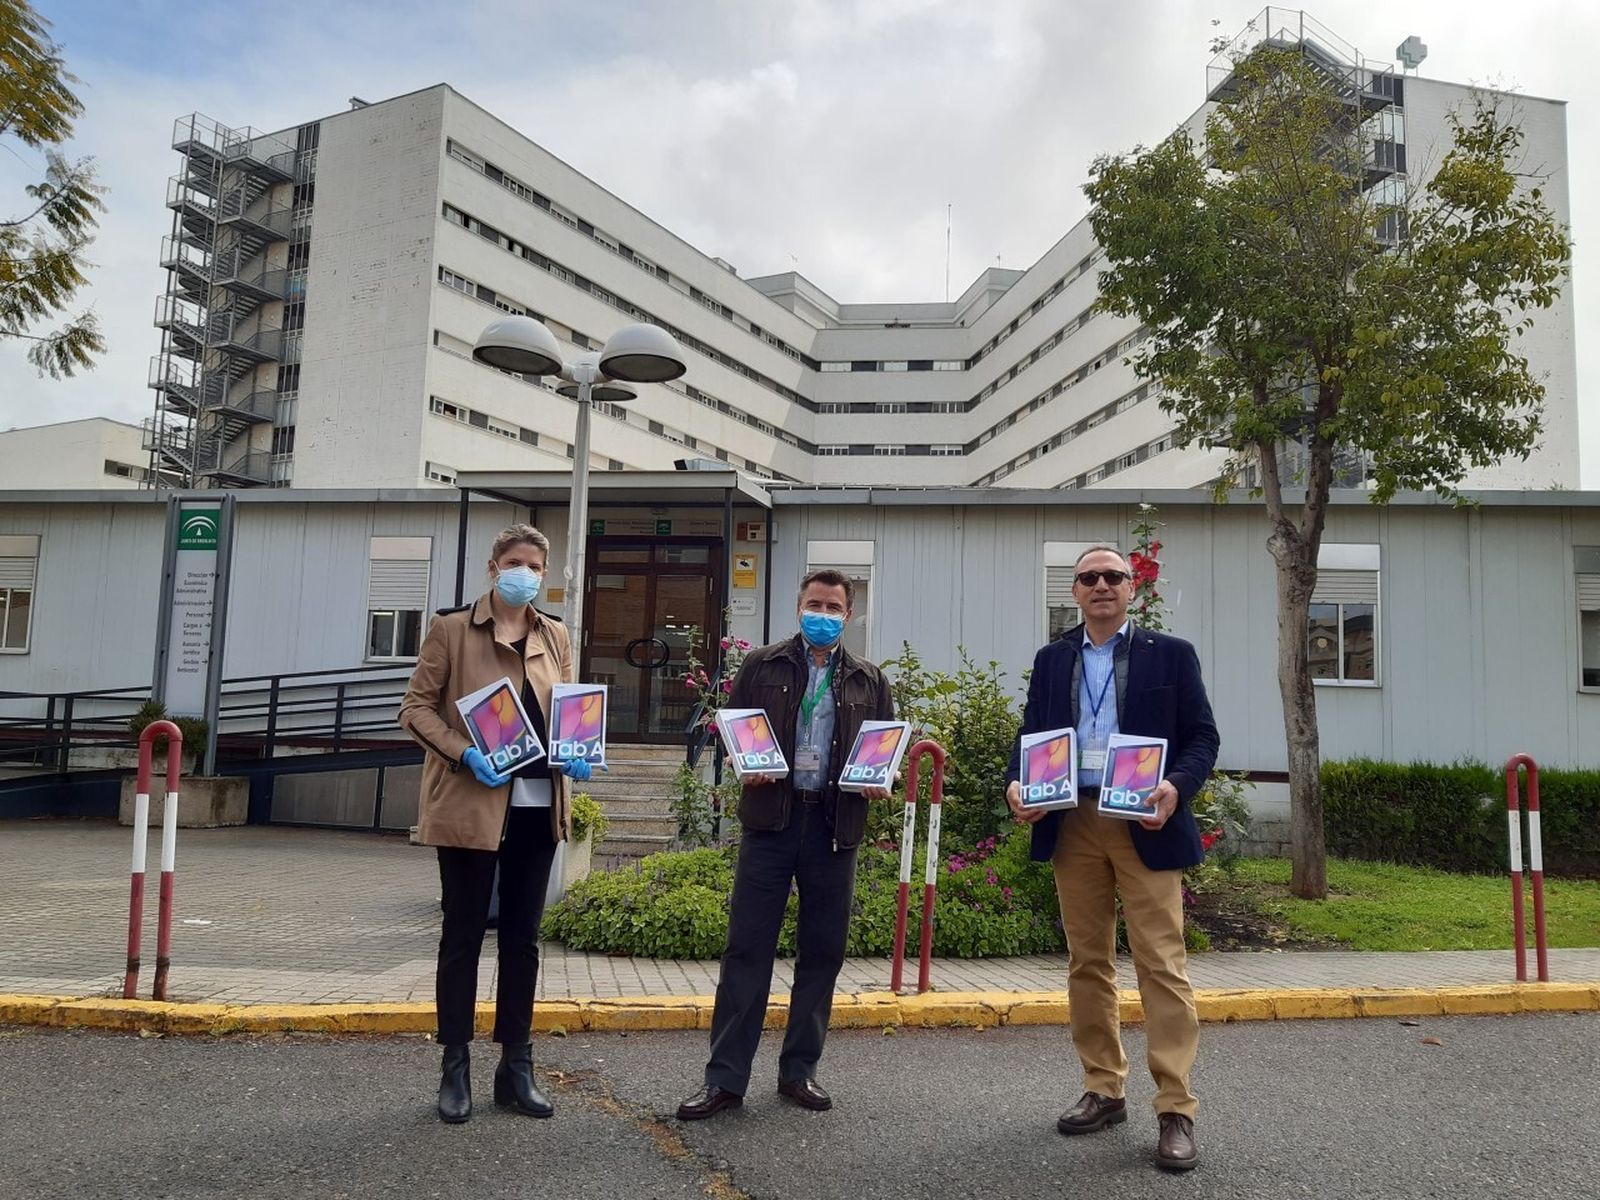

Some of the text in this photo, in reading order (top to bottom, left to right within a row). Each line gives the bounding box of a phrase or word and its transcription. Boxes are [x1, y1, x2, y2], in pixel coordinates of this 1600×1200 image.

[484, 734, 541, 770] Tab A
[551, 740, 604, 757] Tab A
[736, 752, 786, 765] Tab A
[844, 764, 890, 780] Tab A
[1021, 780, 1073, 800] Tab A
[1102, 787, 1141, 806] Tab
